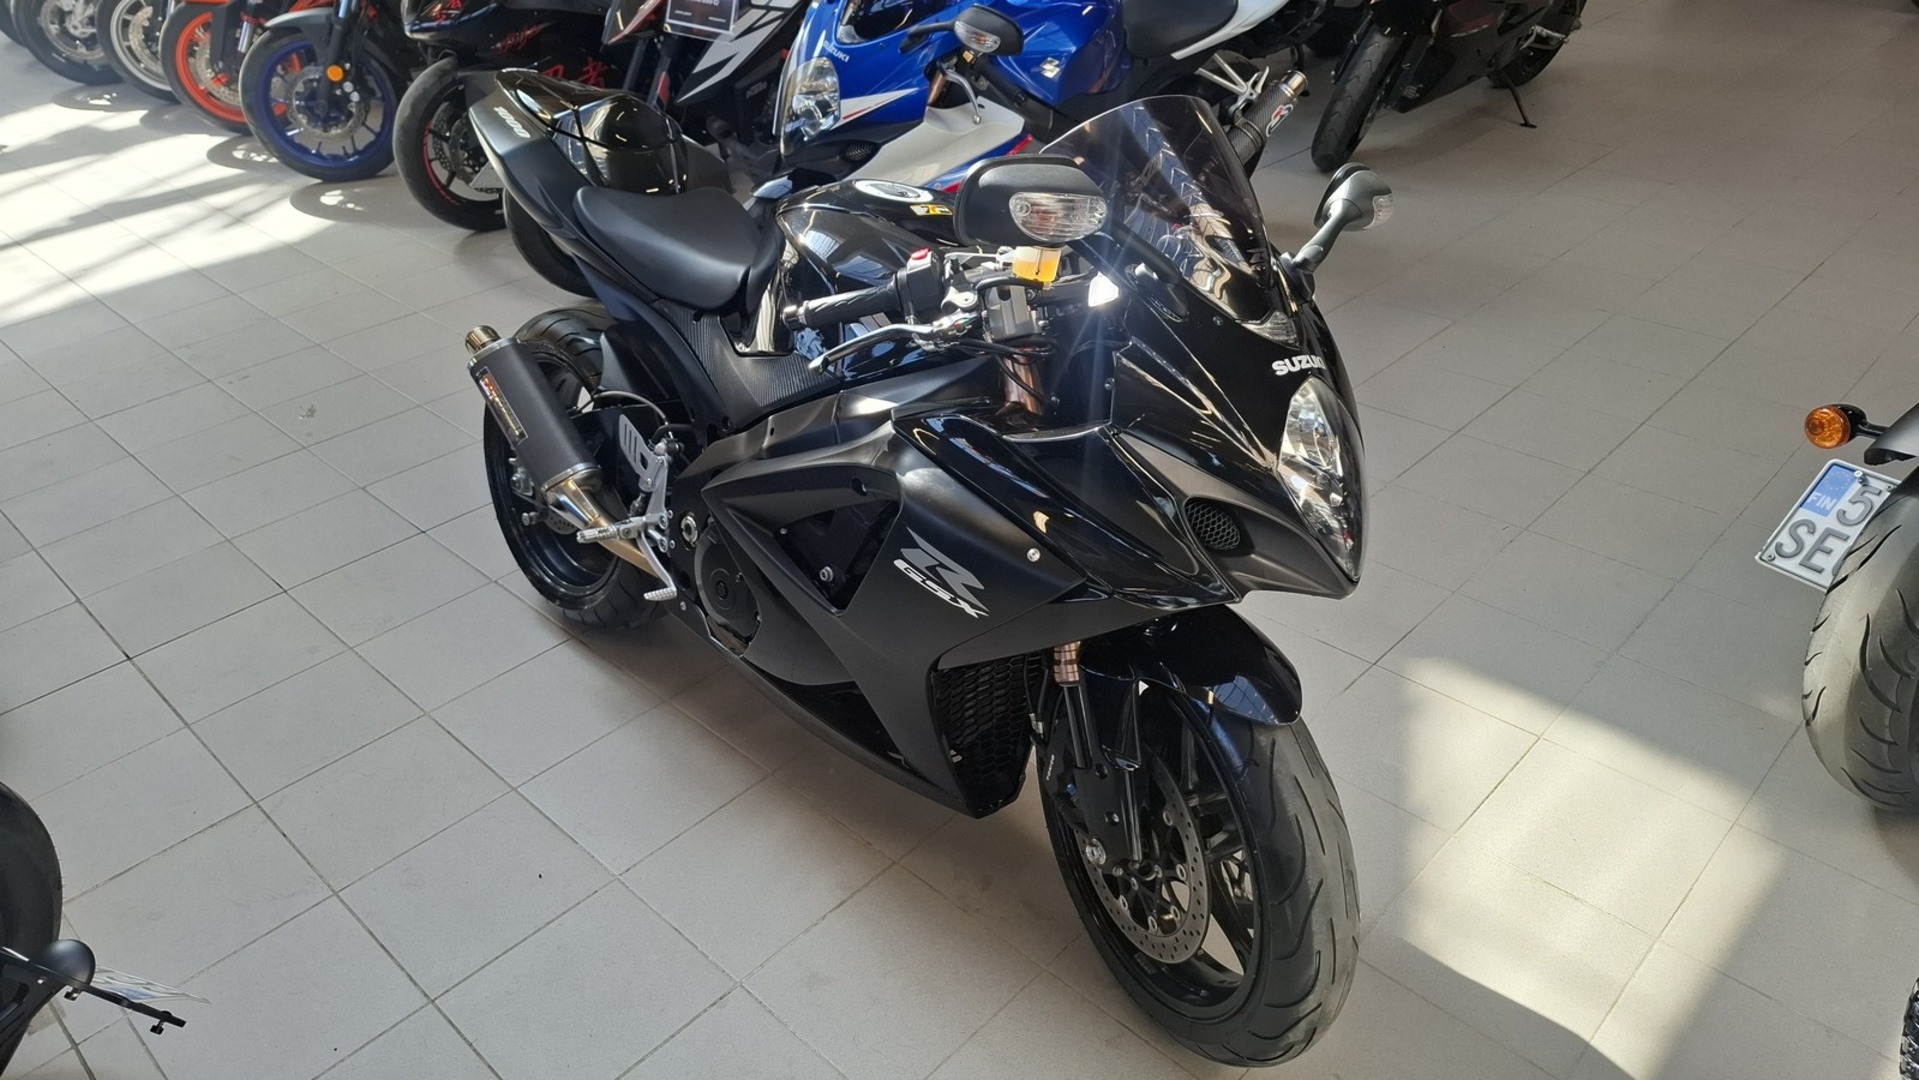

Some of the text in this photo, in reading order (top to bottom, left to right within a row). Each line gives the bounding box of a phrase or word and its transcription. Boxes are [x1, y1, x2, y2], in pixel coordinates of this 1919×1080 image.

[822, 40, 850, 63] SUZUKI
[493, 106, 531, 138] 1000
[1807, 491, 1838, 511] FIN
[893, 558, 990, 619] GSX
